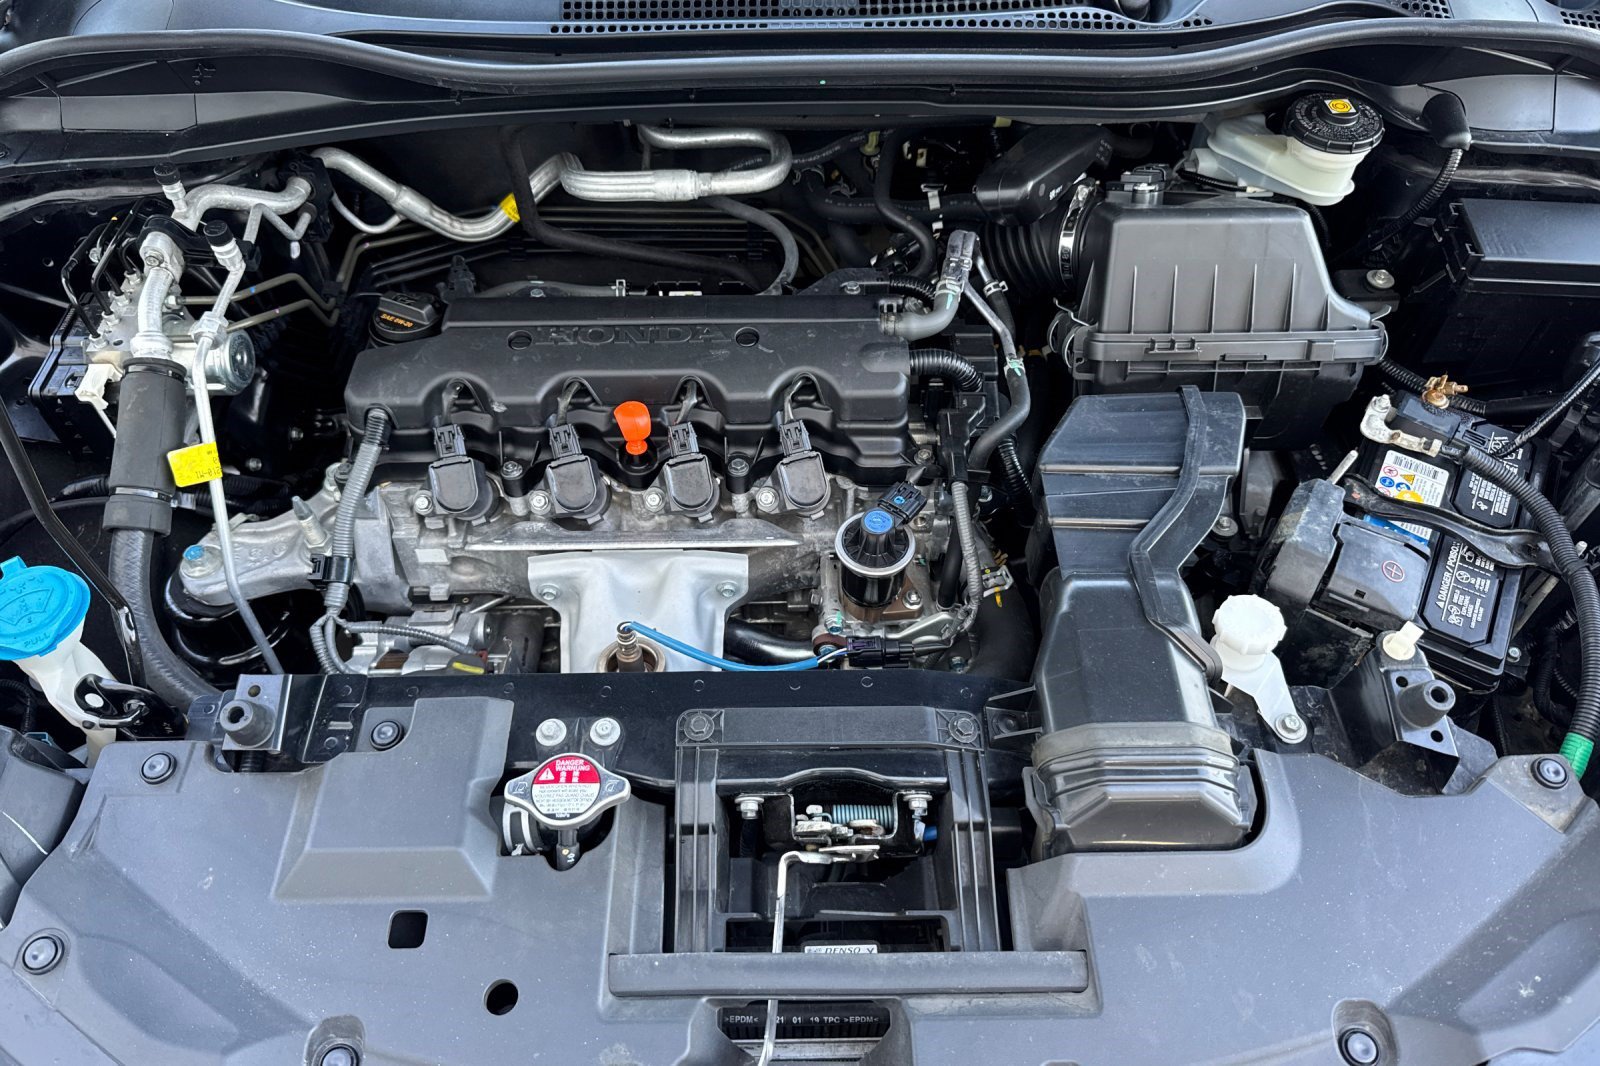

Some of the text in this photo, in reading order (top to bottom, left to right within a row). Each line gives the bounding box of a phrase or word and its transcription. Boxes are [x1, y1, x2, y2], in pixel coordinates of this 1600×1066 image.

[535, 326, 732, 346] HONDA
[1438, 571, 1453, 601] DANGER
[24, 632, 50, 647] PULL
[724, 1016, 759, 1024] >EPDM<
[792, 1016, 801, 1024] 01
[823, 1016, 840, 1024] TPC
[843, 1015, 879, 1023] >EPDM<
